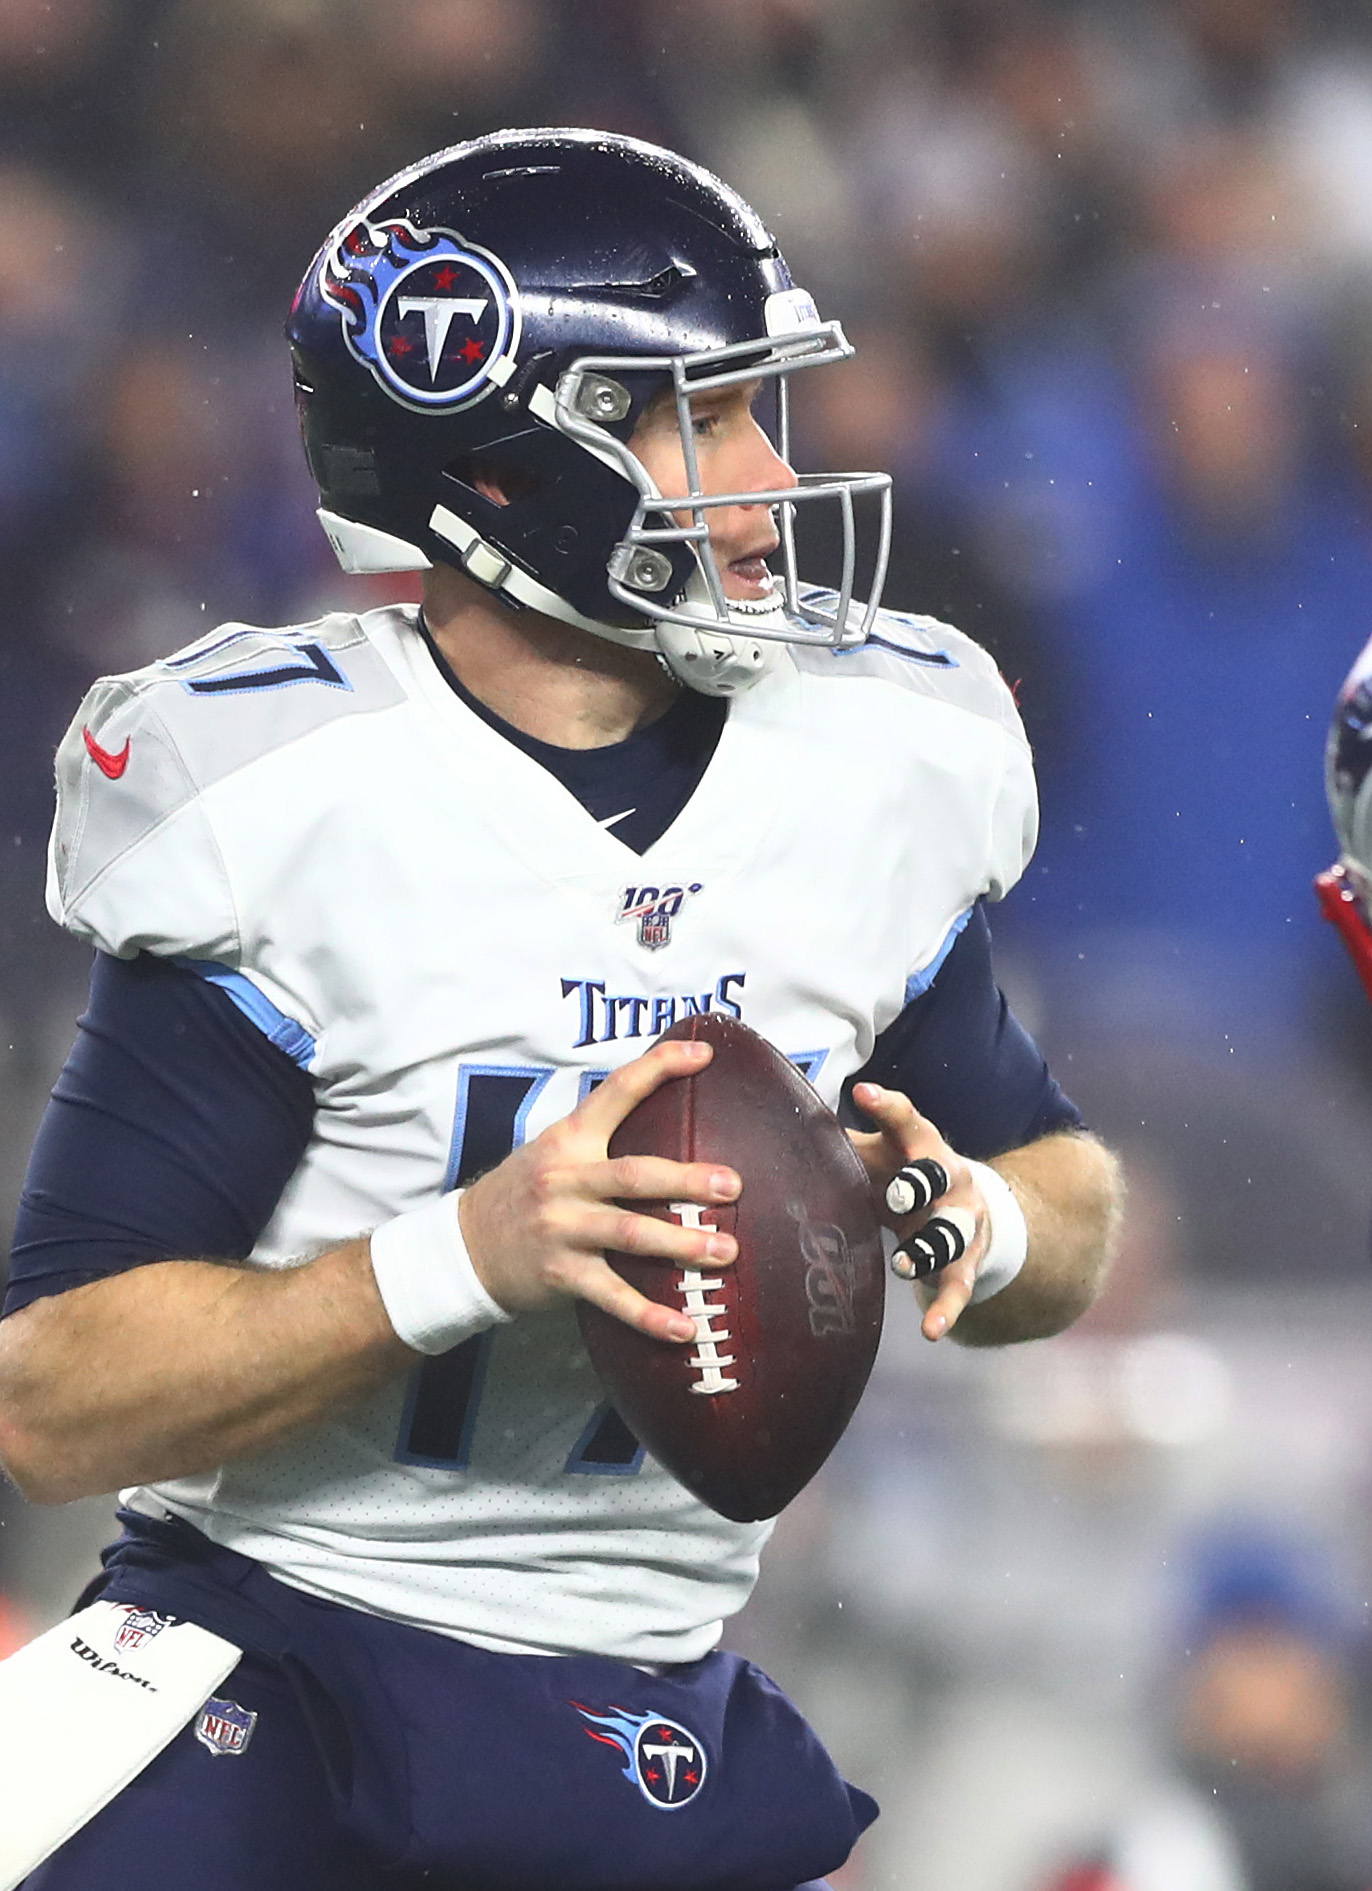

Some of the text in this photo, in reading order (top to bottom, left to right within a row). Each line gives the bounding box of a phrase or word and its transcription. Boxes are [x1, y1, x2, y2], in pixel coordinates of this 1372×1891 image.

[560, 971, 746, 1048] TITANS
[116, 1627, 145, 1648] NFL
[203, 1714, 241, 1746] NFL
